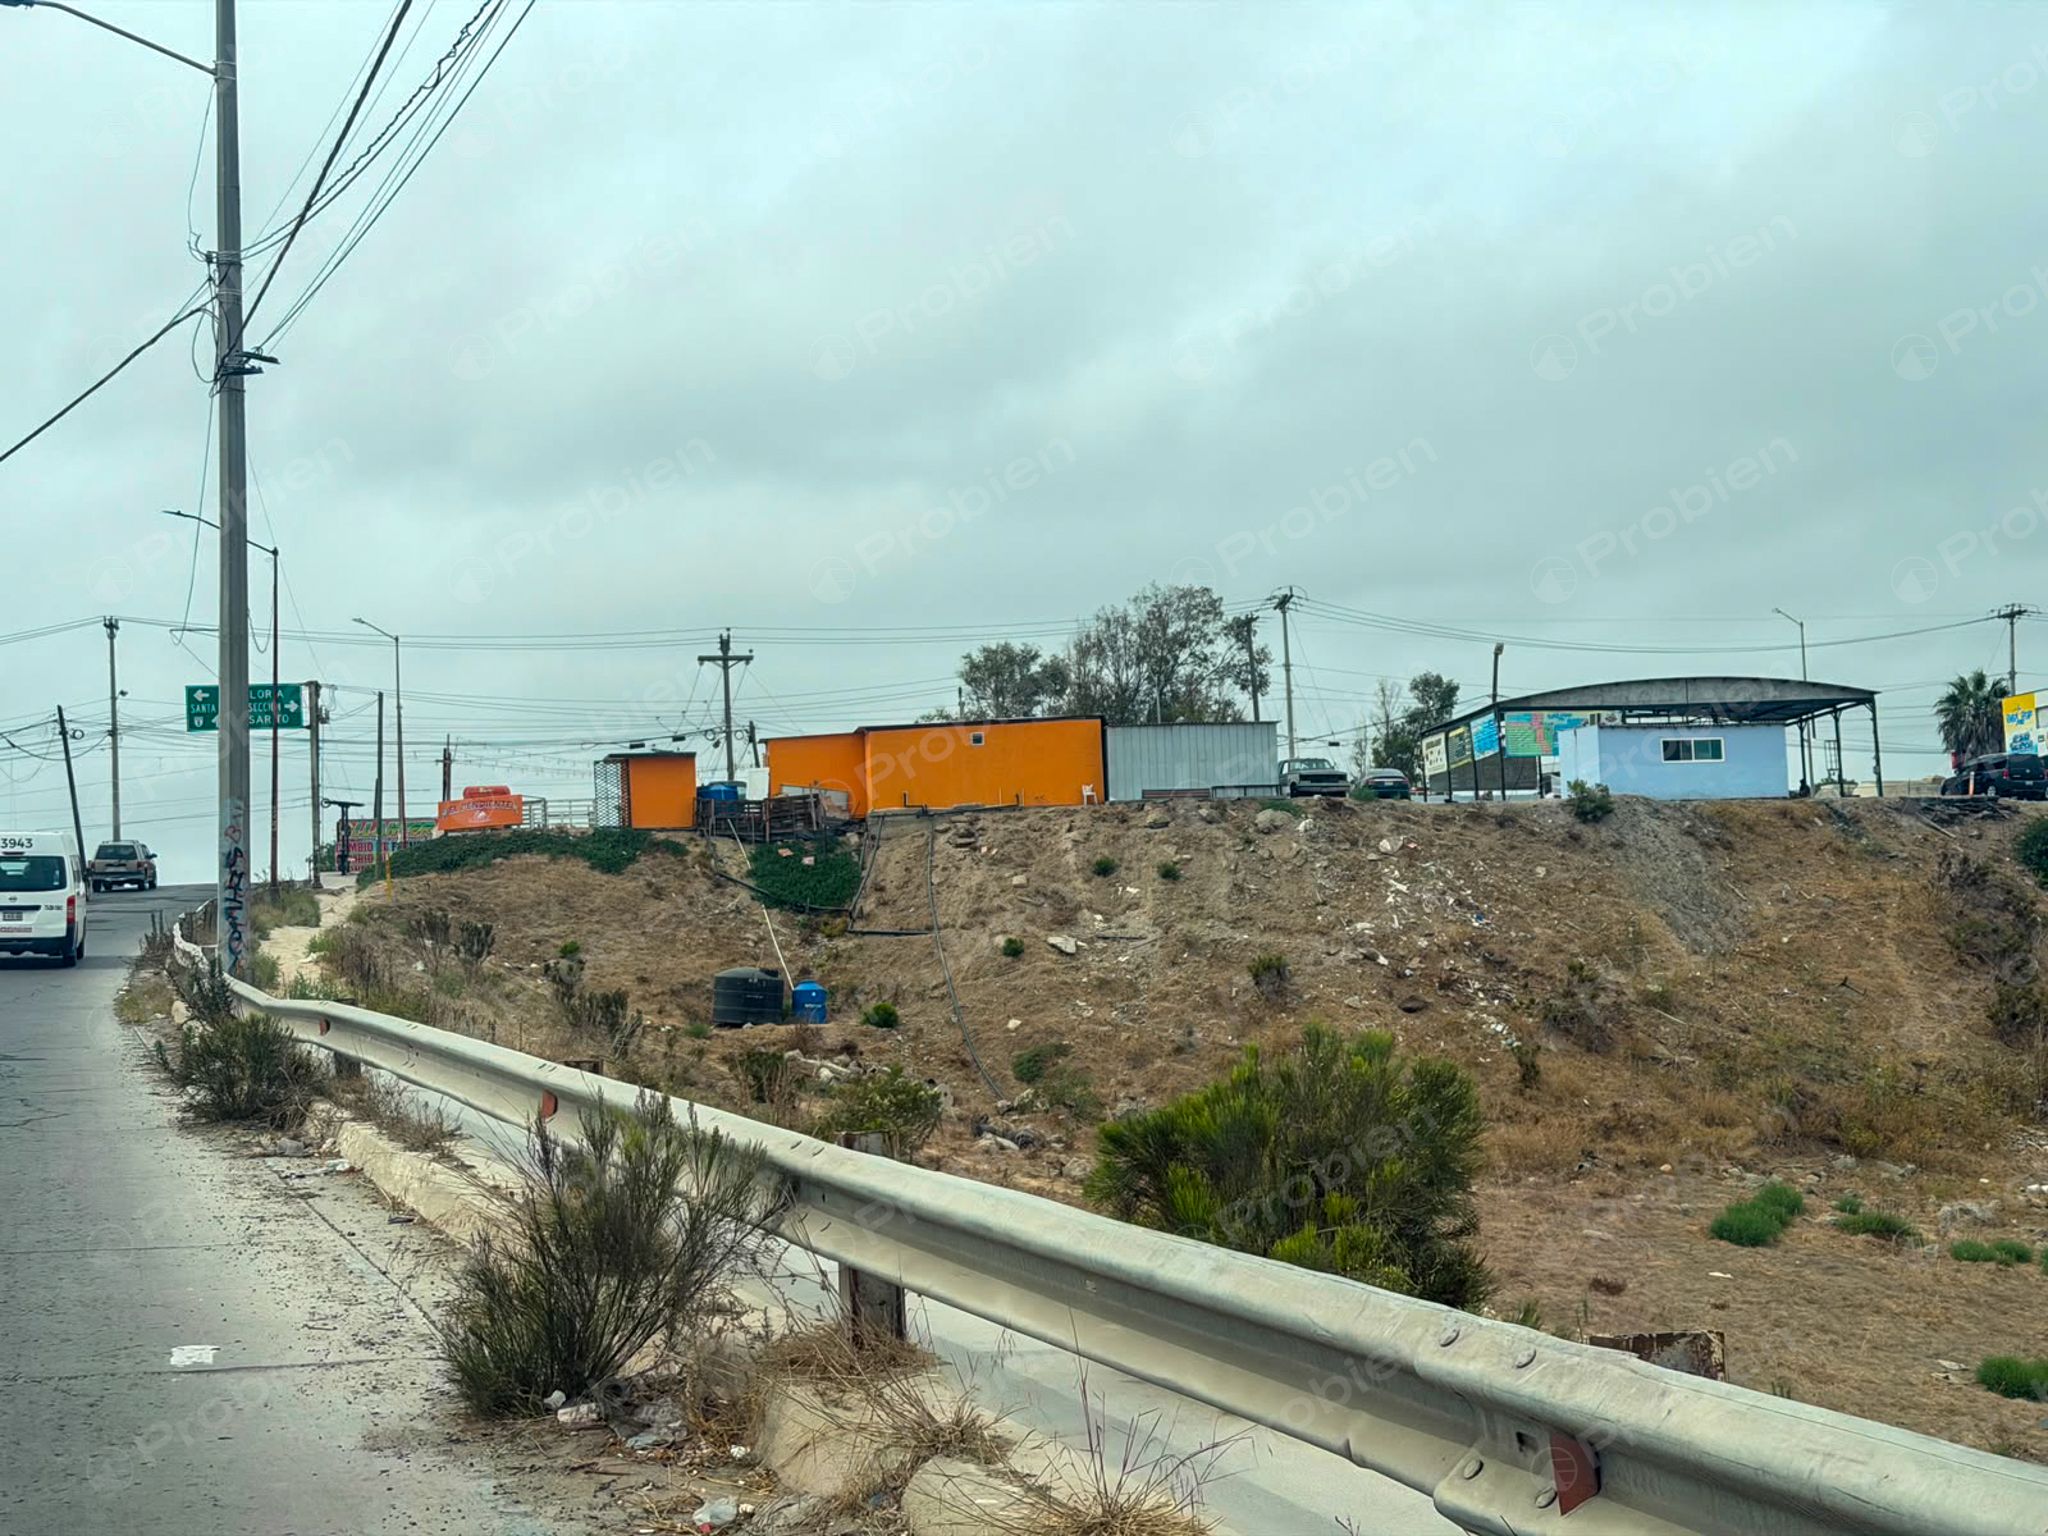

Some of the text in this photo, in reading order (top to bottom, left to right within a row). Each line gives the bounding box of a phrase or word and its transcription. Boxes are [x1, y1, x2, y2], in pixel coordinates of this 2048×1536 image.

[249, 689, 284, 699] LORA
[190, 703, 217, 714] SANTA
[249, 714, 289, 724] SARTO
[0, 838, 33, 849] 3943
